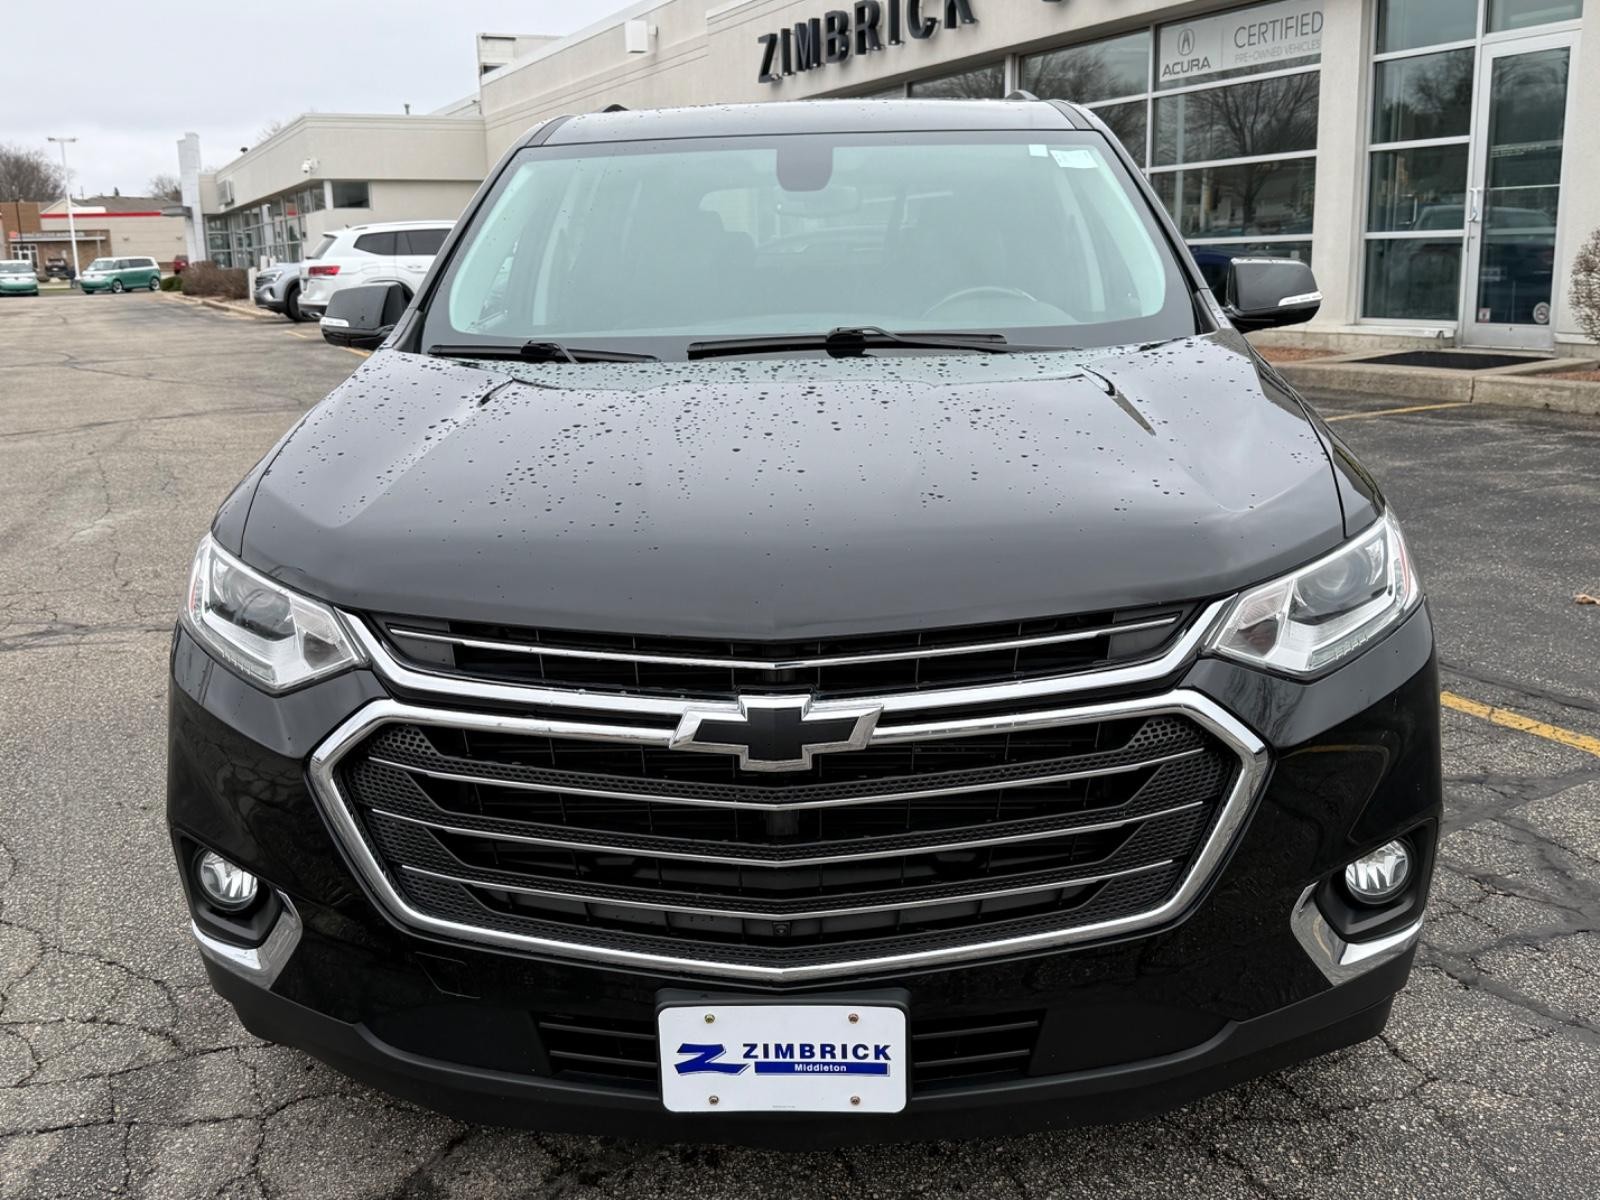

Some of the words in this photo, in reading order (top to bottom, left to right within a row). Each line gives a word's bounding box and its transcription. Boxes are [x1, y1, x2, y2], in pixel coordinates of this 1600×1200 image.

[758, 0, 978, 83] ZIMBRICK
[1234, 11, 1324, 49] CERTIFIED
[1234, 47, 1282, 64] PRE-OWNED
[1284, 40, 1321, 55] VEHICLES
[1162, 56, 1212, 78] ACURA
[742, 1043, 892, 1061] ZIMBRICK
[794, 1063, 847, 1073] Middleton
